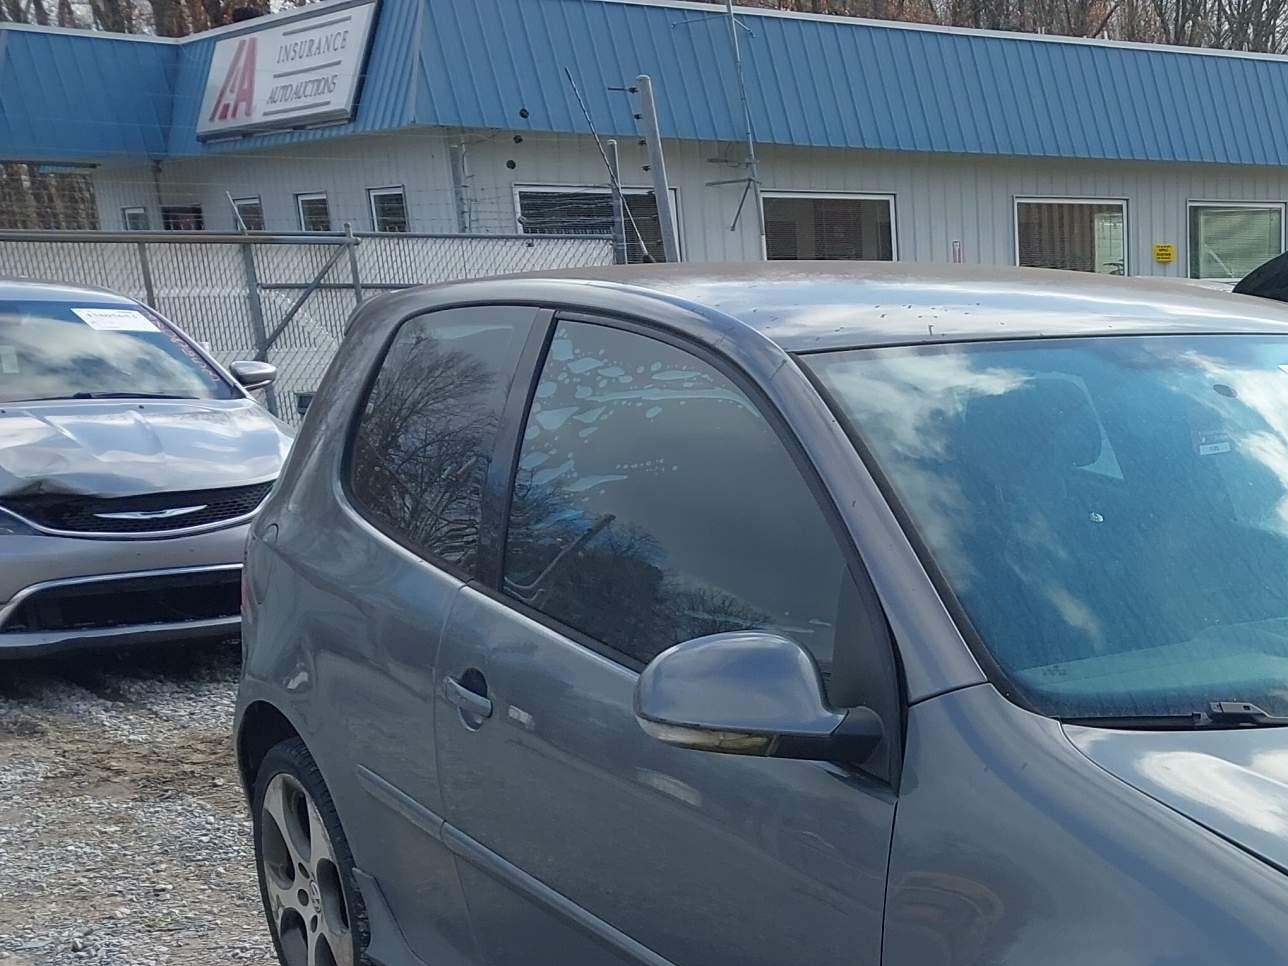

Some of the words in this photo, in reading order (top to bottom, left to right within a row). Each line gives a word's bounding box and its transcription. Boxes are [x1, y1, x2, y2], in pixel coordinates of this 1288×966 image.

[276, 30, 349, 64] INSURANCE
[266, 83, 293, 104] AUTO
[291, 74, 338, 101] AUCTIONS
